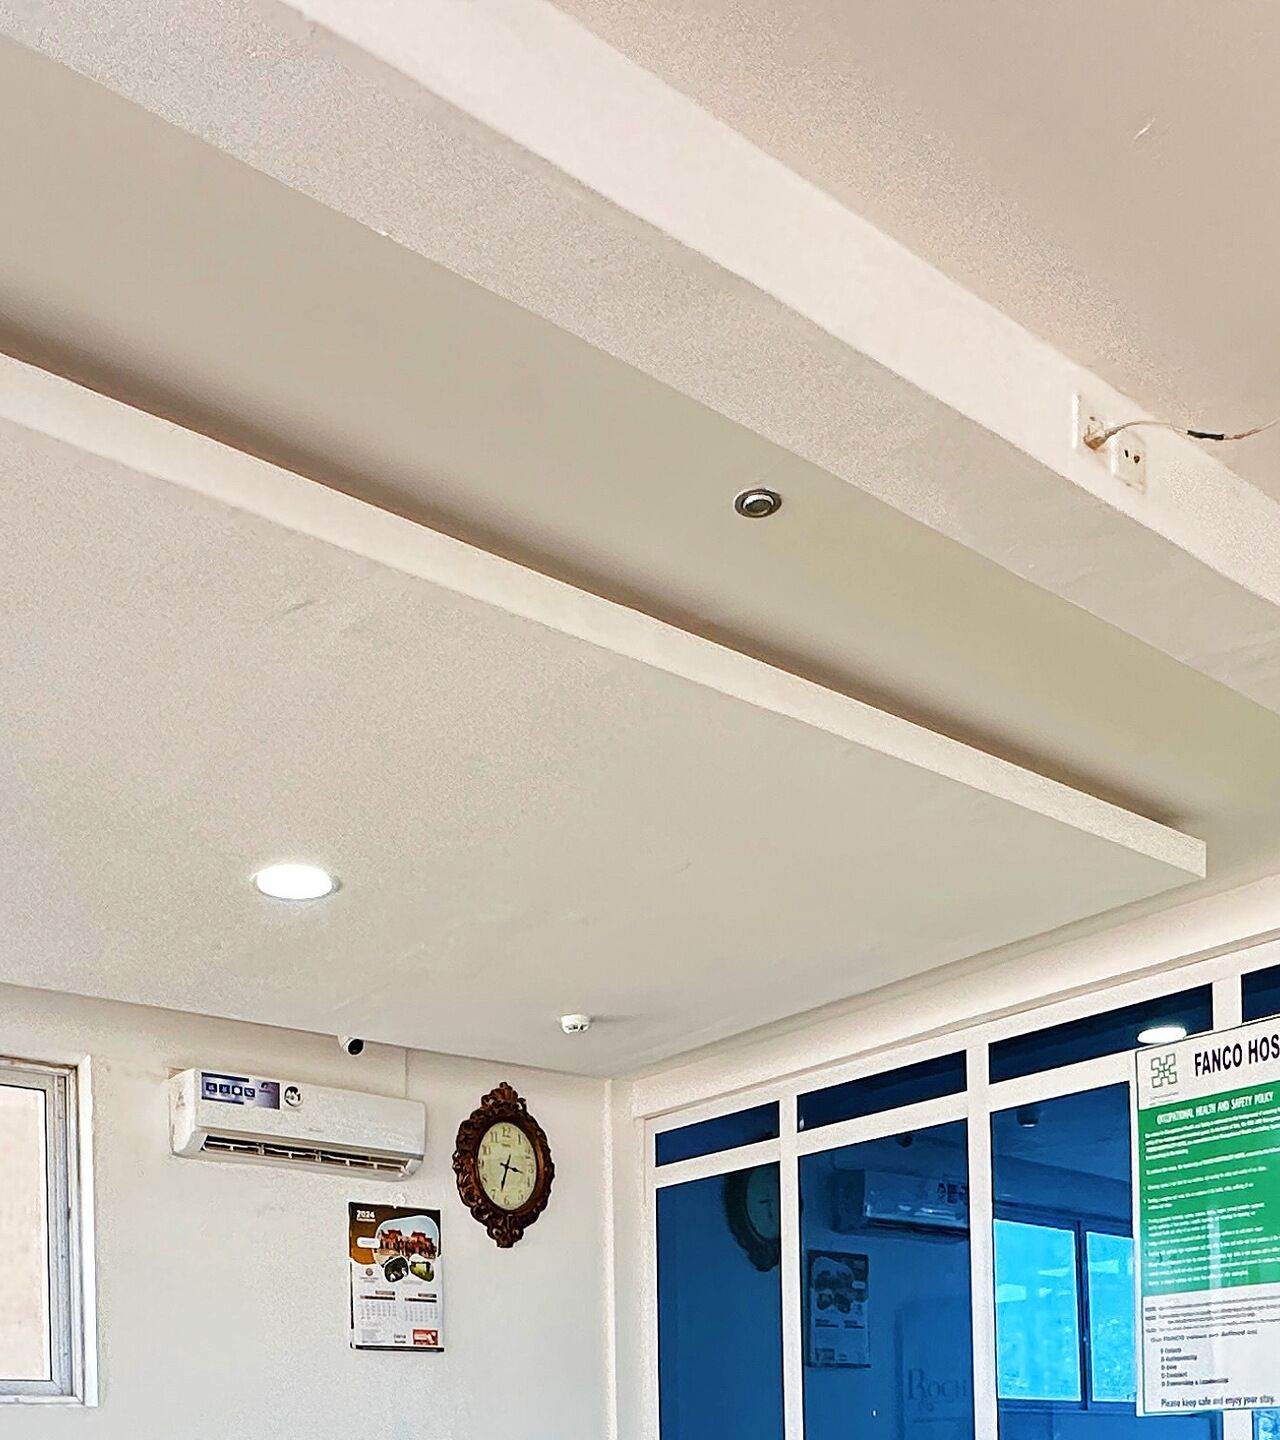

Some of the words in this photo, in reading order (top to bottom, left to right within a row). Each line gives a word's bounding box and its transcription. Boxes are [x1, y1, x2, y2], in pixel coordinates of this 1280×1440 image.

[1194, 1043, 1243, 1077] FANCO
[1231, 1096, 1252, 1111] SAFETY
[1254, 1091, 1274, 1106] POLICY
[1160, 1398, 1181, 1408] Please
[1182, 1397, 1197, 1407] keep
[1198, 1396, 1212, 1405] safe
[1225, 1396, 1242, 1406] enjoy
[1243, 1396, 1258, 1404] your
